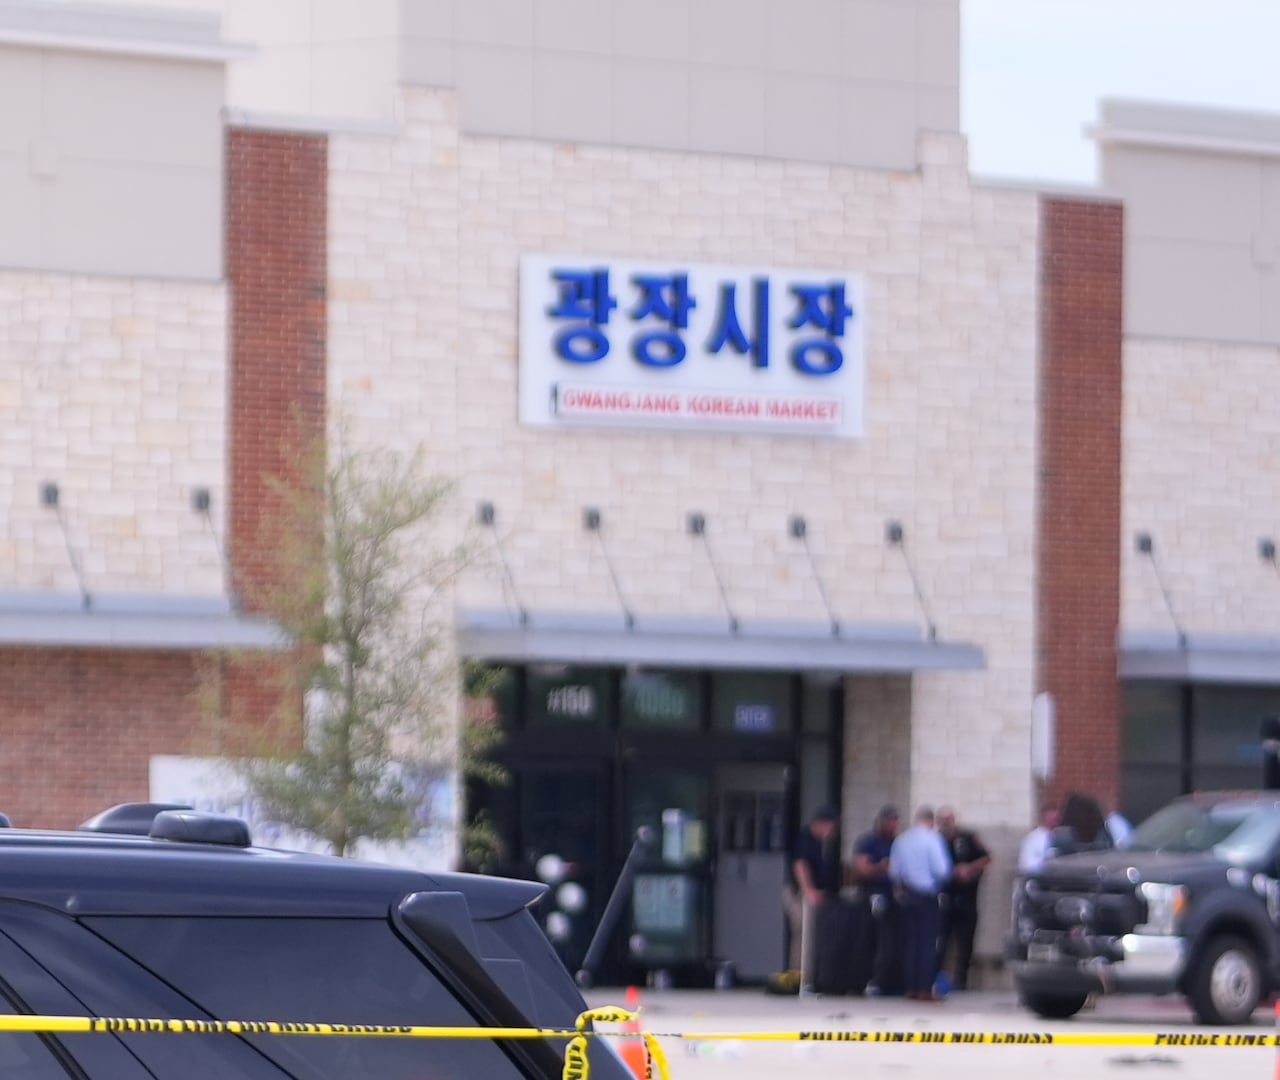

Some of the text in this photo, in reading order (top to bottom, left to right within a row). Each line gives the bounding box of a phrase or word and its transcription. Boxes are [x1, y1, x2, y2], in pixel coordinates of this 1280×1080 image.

[546, 266, 855, 376] 광장시장
[562, 388, 839, 421] GWANGJANG KOREAN MARKET
